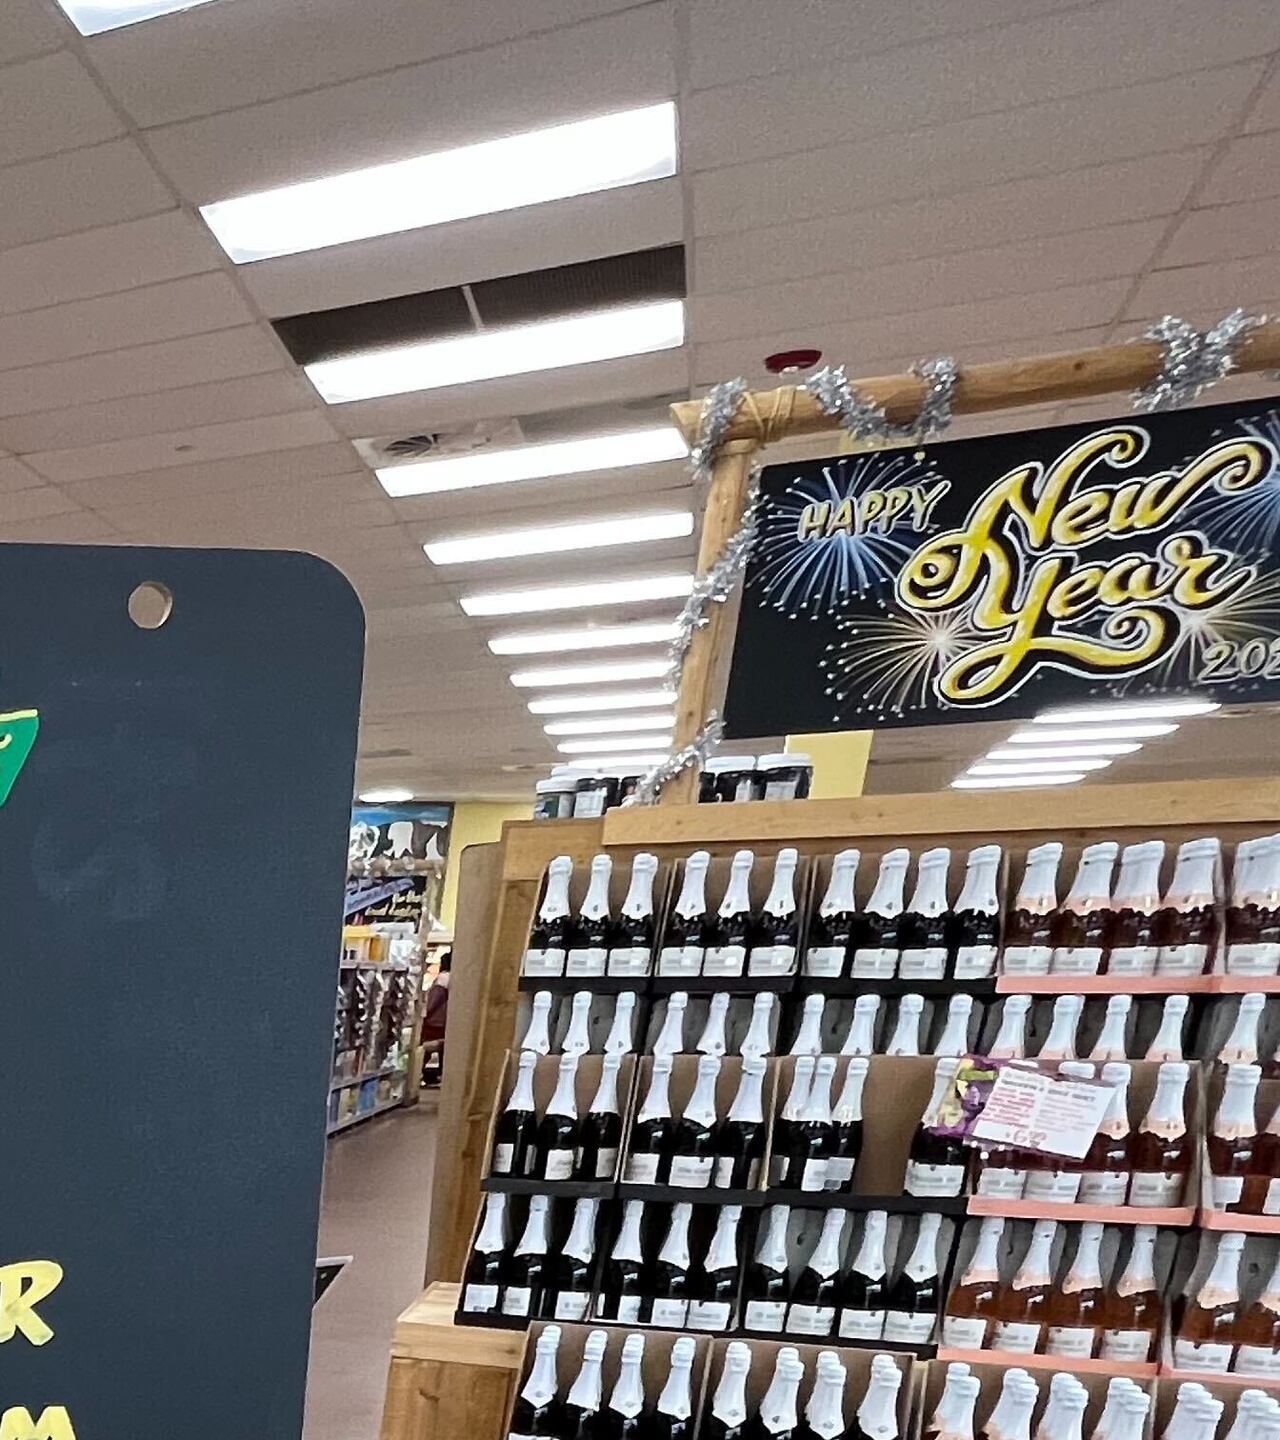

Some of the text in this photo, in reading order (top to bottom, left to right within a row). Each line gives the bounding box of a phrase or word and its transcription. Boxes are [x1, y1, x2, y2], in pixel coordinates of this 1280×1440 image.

[796, 480, 952, 543] HAPPY
[897, 426, 1277, 613] New
[933, 530, 1257, 709] Year
